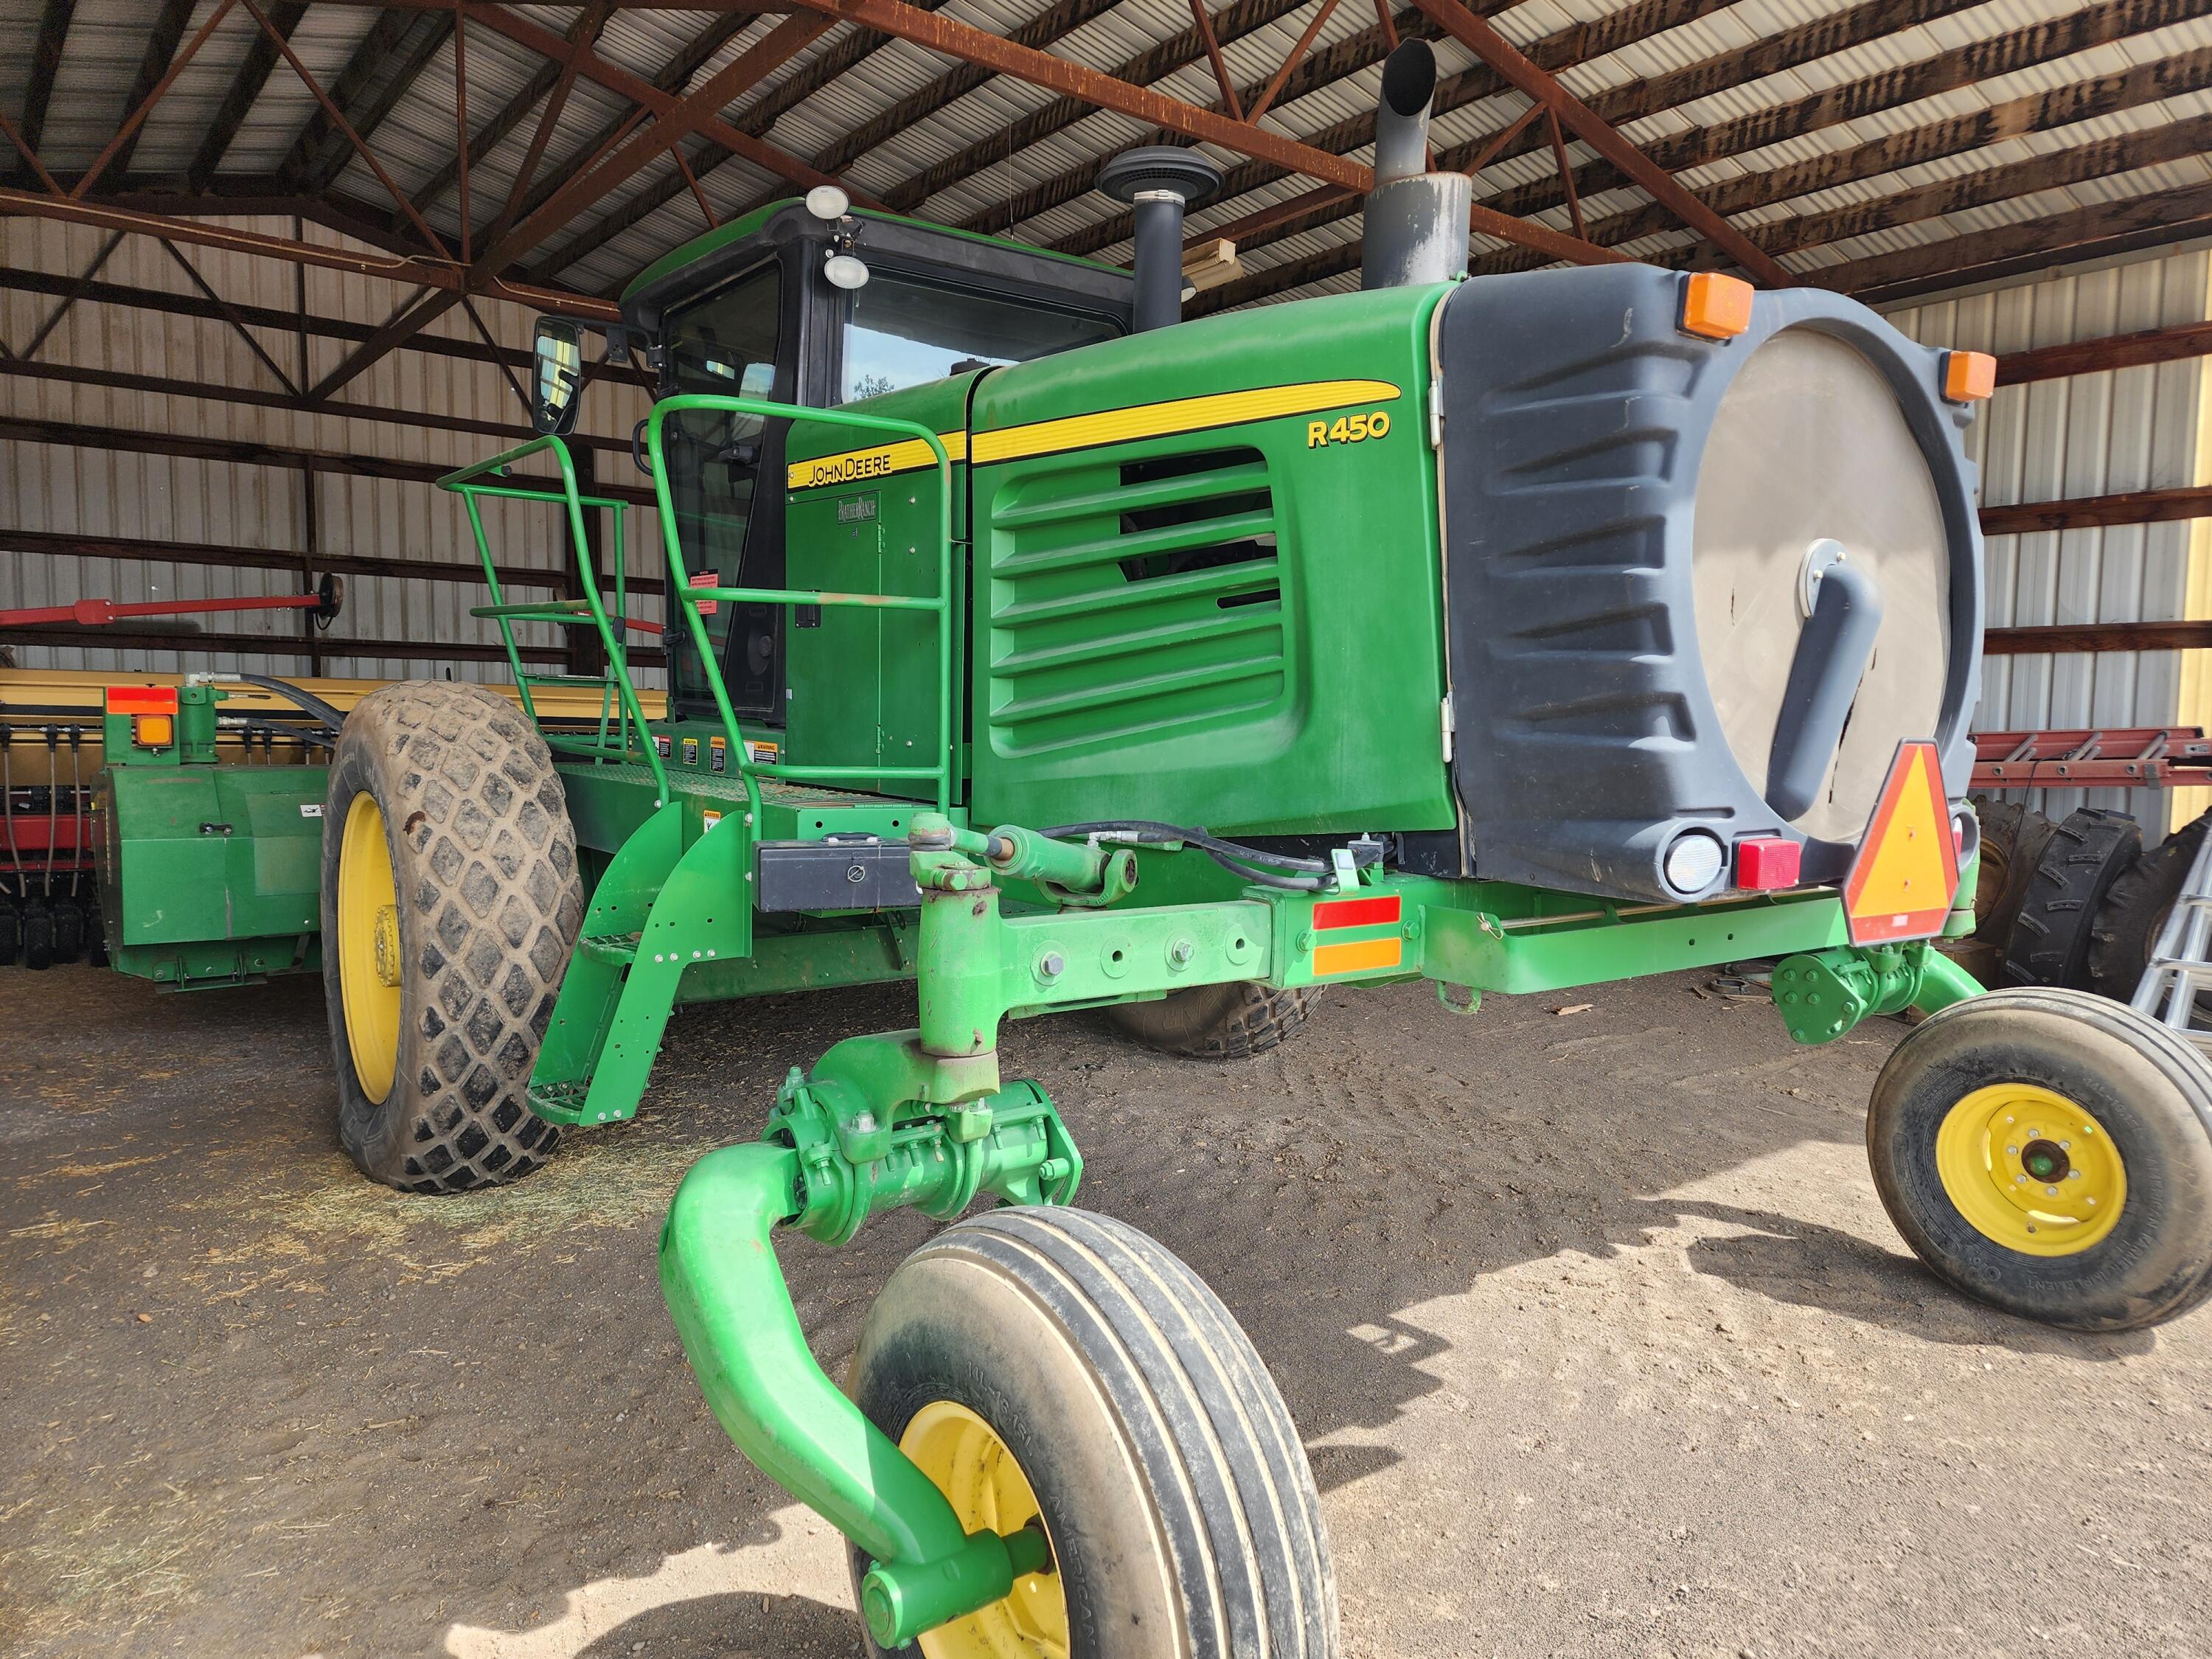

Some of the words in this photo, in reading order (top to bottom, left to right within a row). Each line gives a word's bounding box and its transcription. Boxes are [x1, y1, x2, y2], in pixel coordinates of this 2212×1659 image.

[1308, 410, 1391, 449] R450
[809, 463, 843, 484] JOHN
[845, 454, 891, 478] DEERE
[1049, 1496, 1096, 1646] AMERICAN
